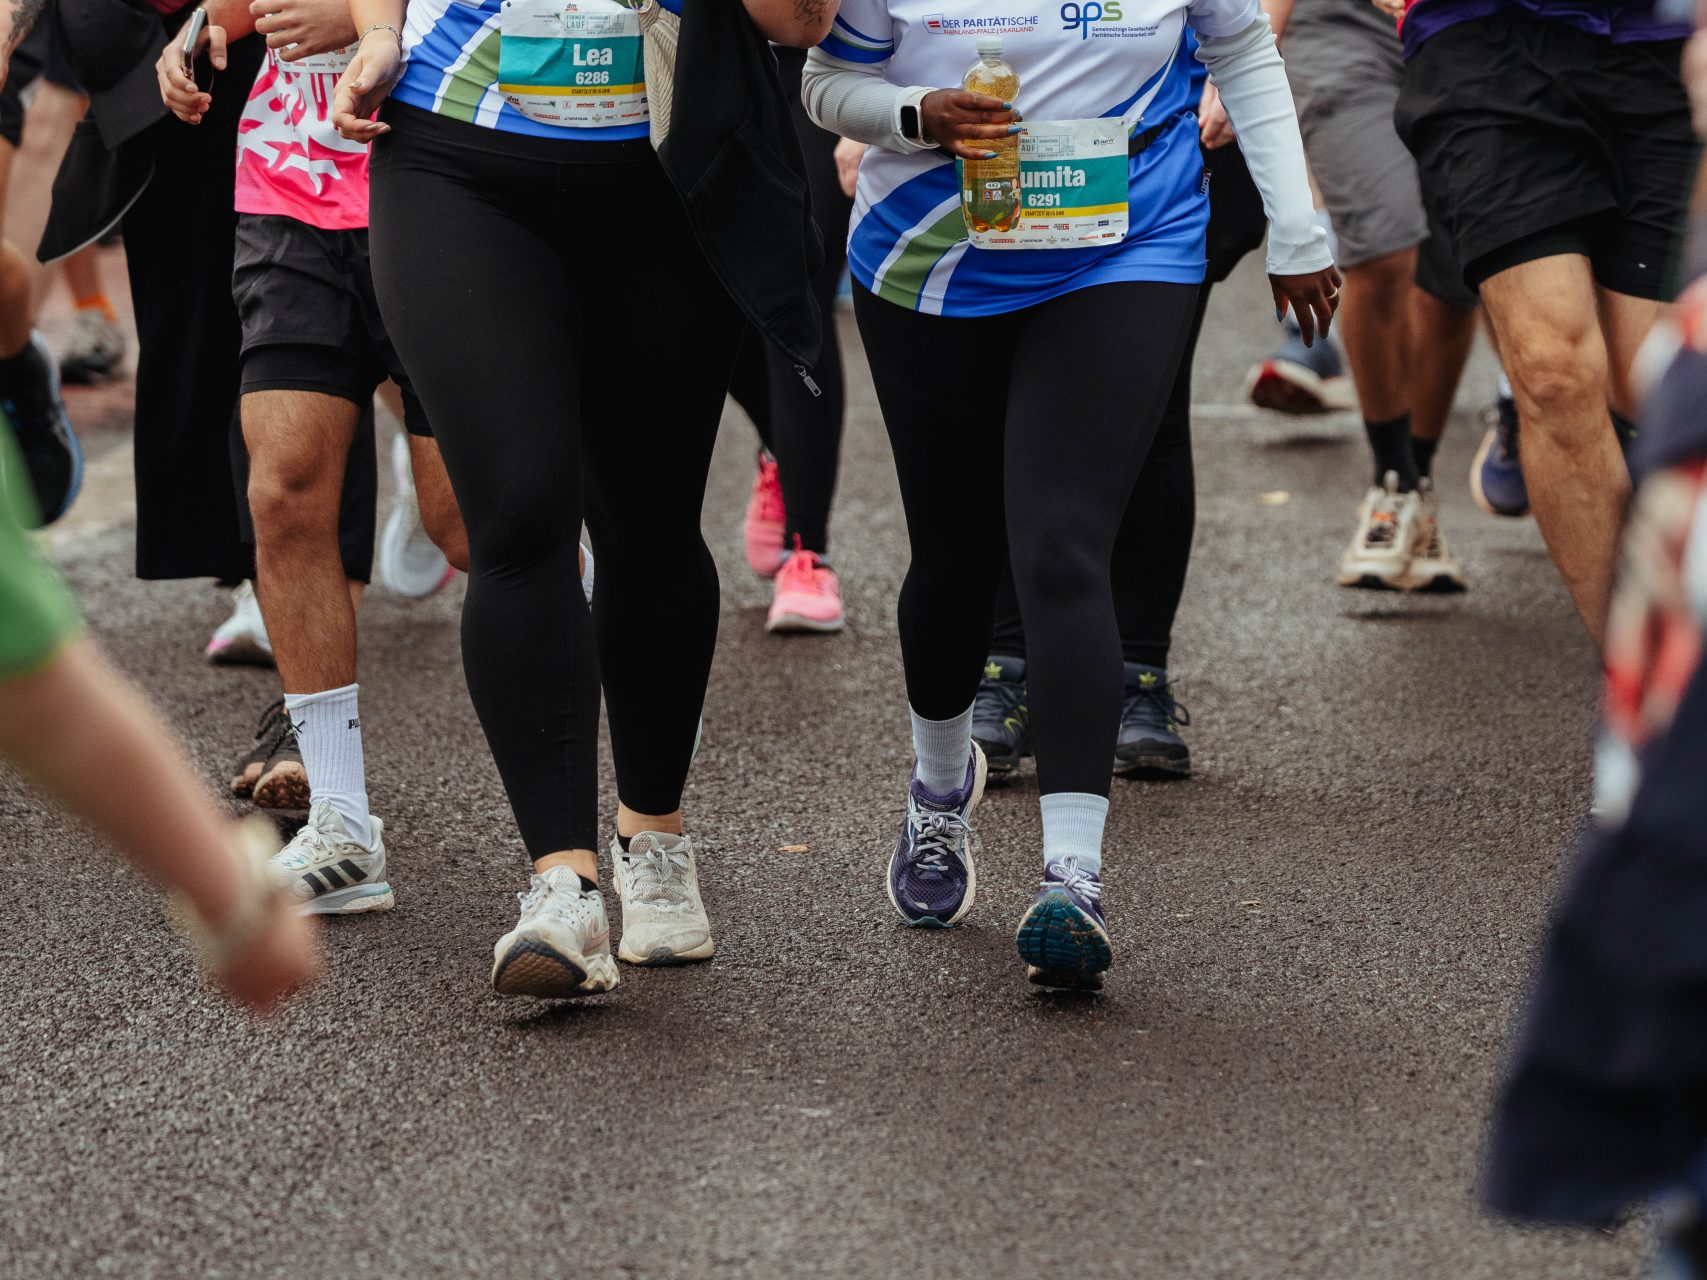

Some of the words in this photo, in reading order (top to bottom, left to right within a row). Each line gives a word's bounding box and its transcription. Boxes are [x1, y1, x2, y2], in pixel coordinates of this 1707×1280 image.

[566, 21, 586, 29] LAUF
[942, 19, 960, 28] DER
[963, 16, 1039, 28] PARITÄTISCHE
[1060, 1, 1123, 40] gps
[573, 43, 613, 66] Lea
[575, 71, 610, 85] 6286
[1021, 144, 1036, 152] AUF
[1020, 166, 1086, 188] umita
[1028, 193, 1060, 207] 6291
